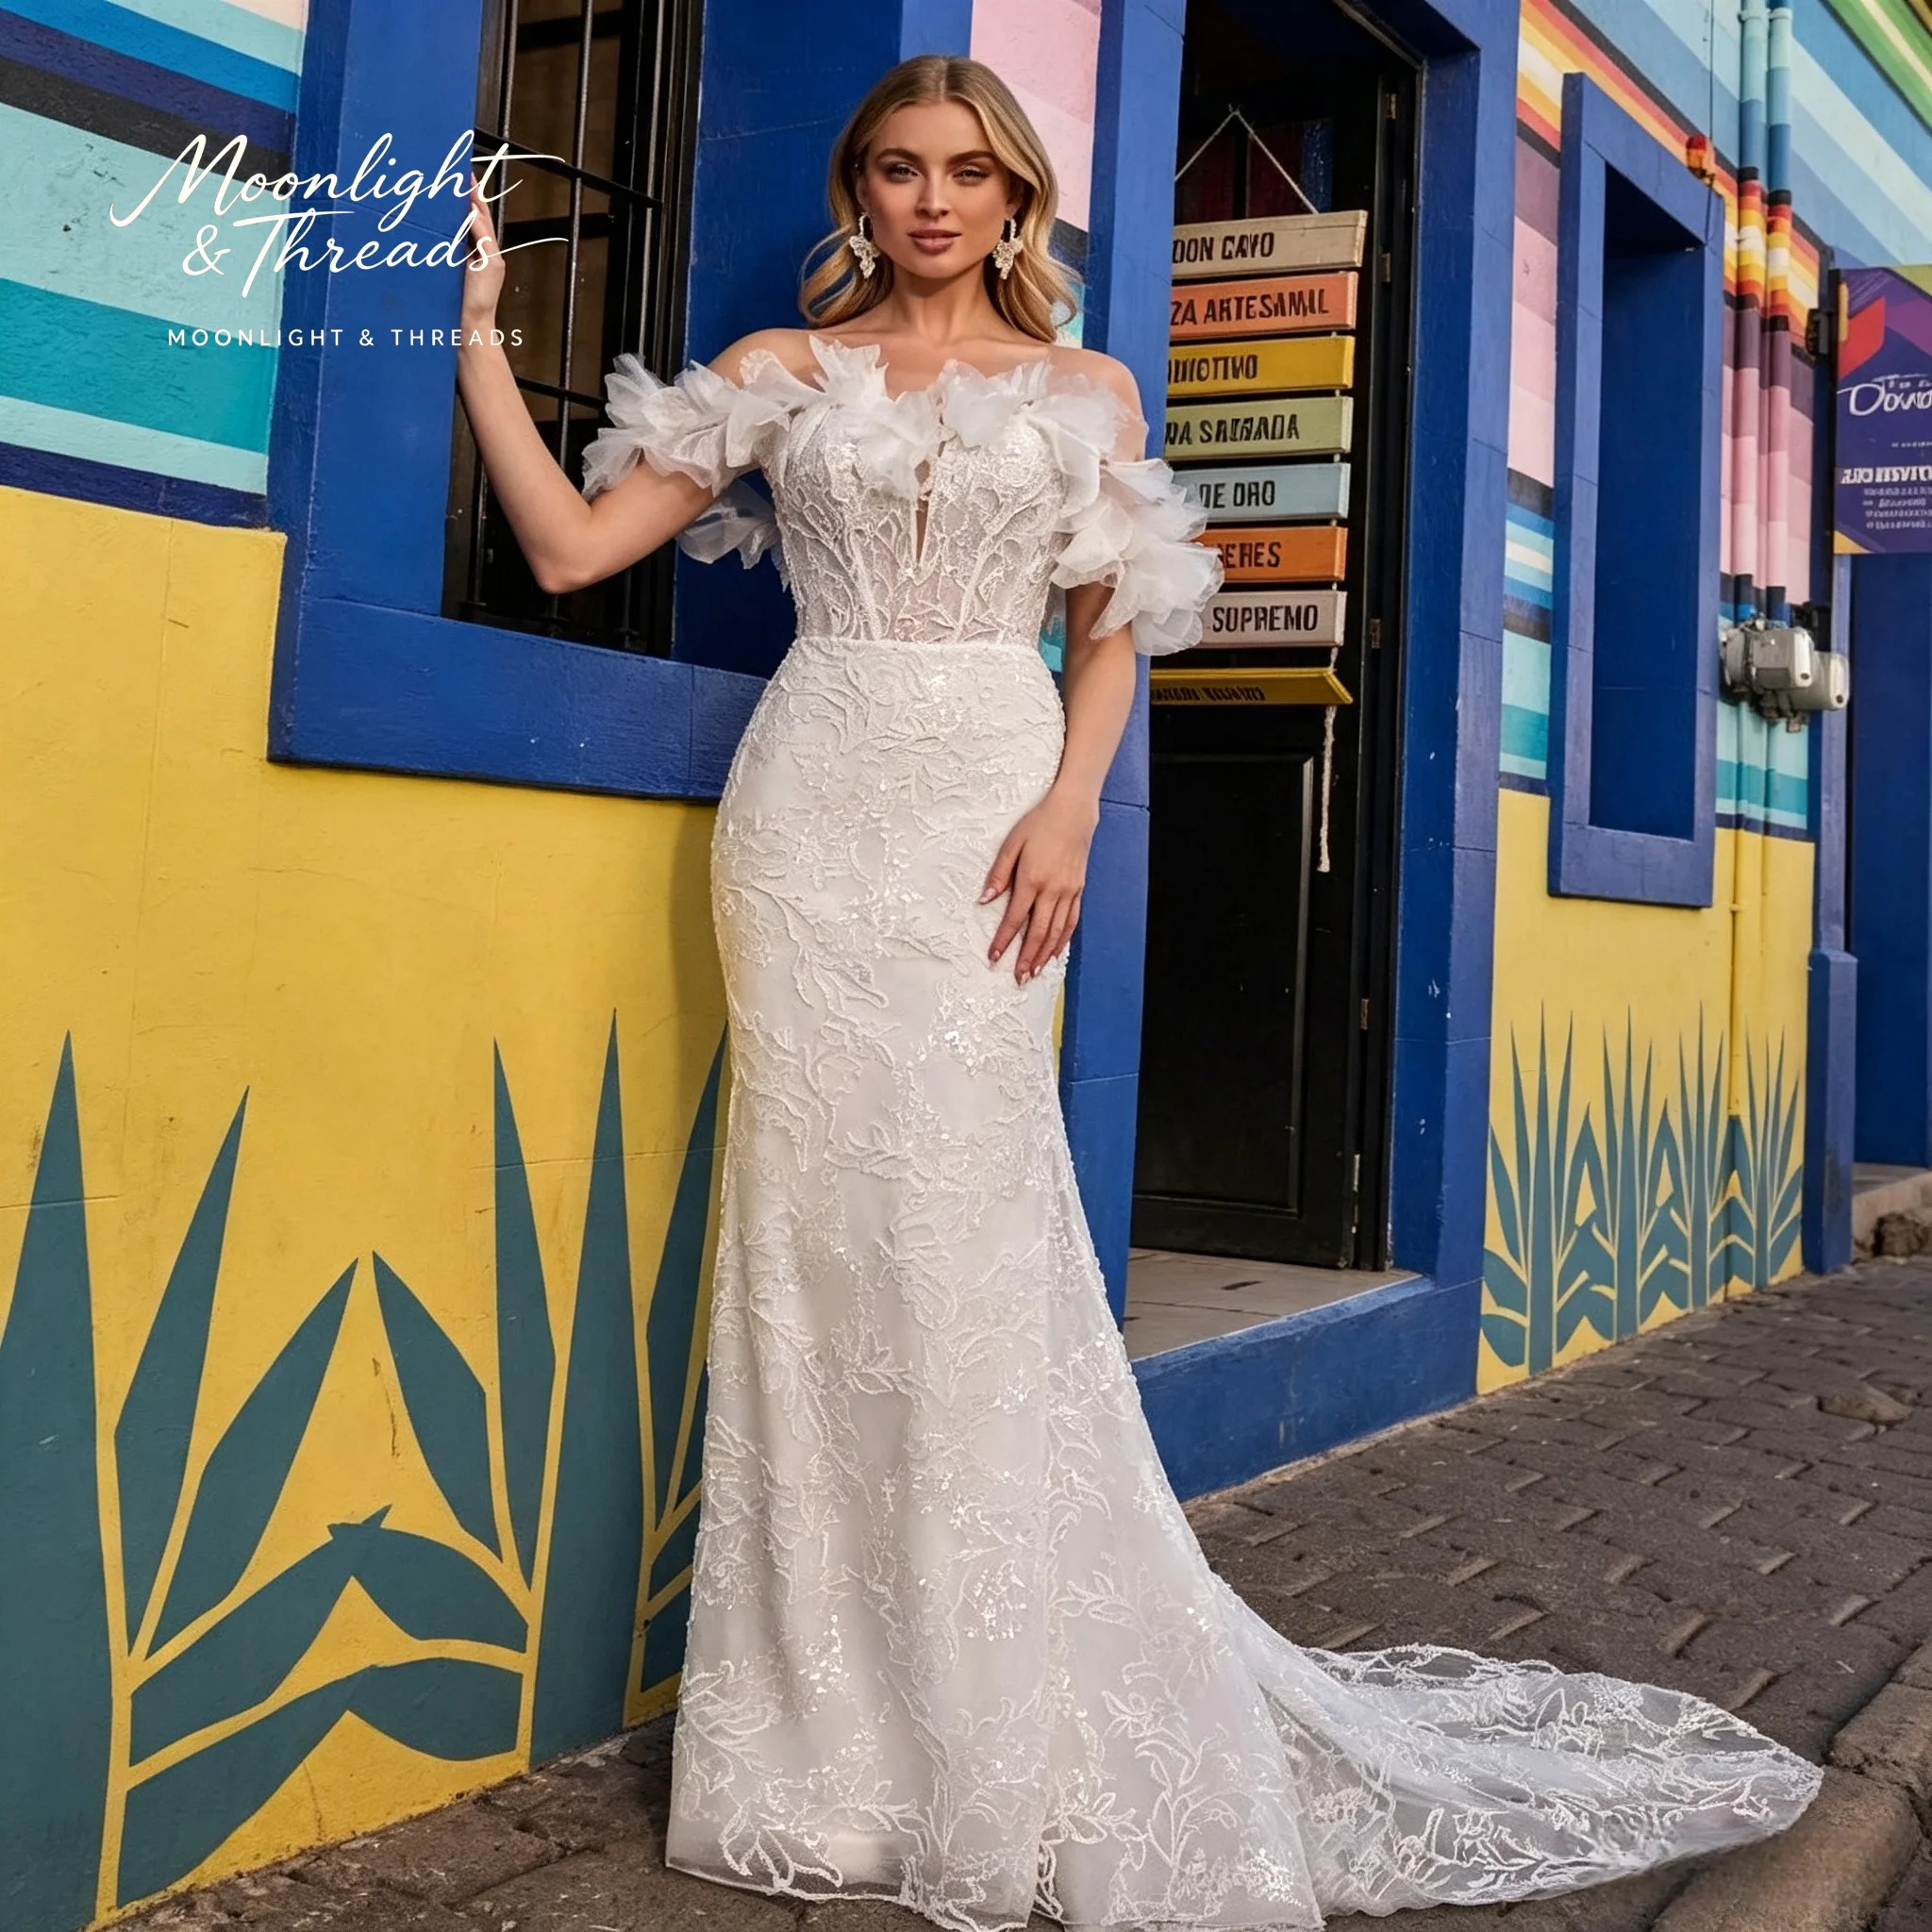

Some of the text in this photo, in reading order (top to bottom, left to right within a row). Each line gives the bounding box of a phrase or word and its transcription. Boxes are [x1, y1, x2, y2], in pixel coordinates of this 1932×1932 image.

[1173, 237, 1214, 263] DON
[1233, 479, 1275, 508] ORO
[1212, 604, 1318, 633] SUPREMO
